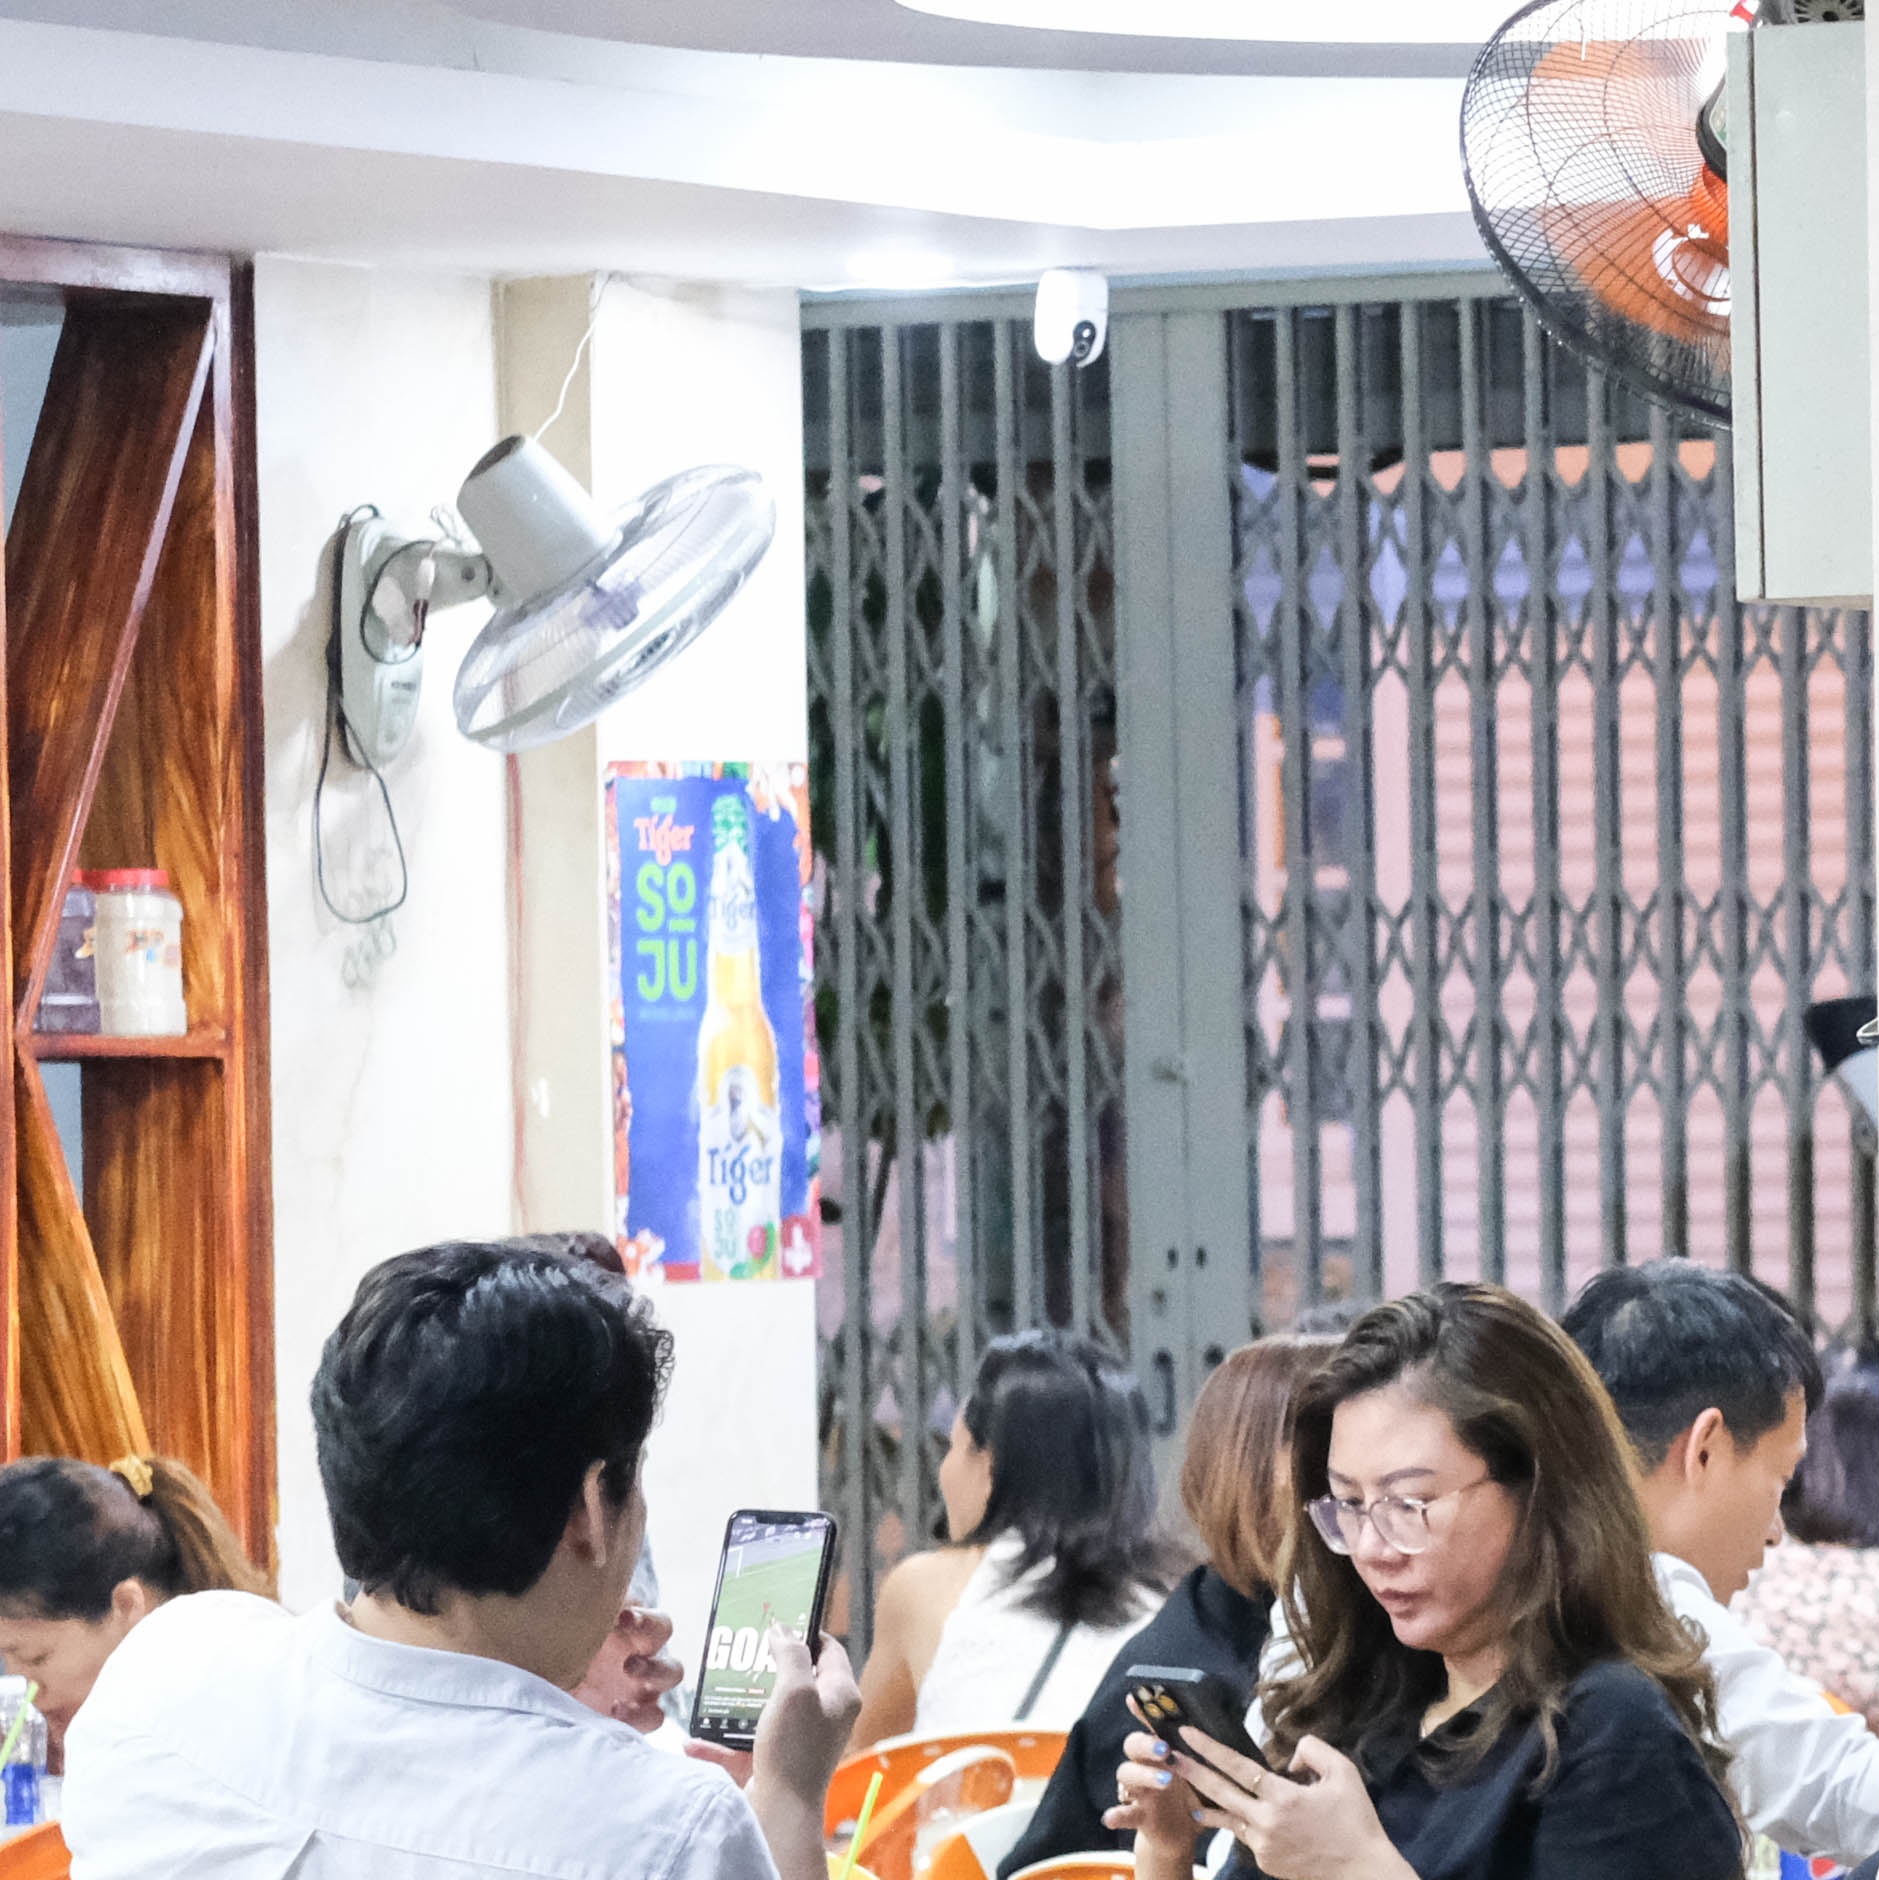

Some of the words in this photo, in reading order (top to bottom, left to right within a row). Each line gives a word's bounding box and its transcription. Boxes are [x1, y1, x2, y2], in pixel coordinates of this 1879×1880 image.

[633, 813, 695, 866] Tiger
[636, 862, 696, 932] SO
[637, 938, 697, 1002] JU
[707, 1144, 774, 1206] Tiger
